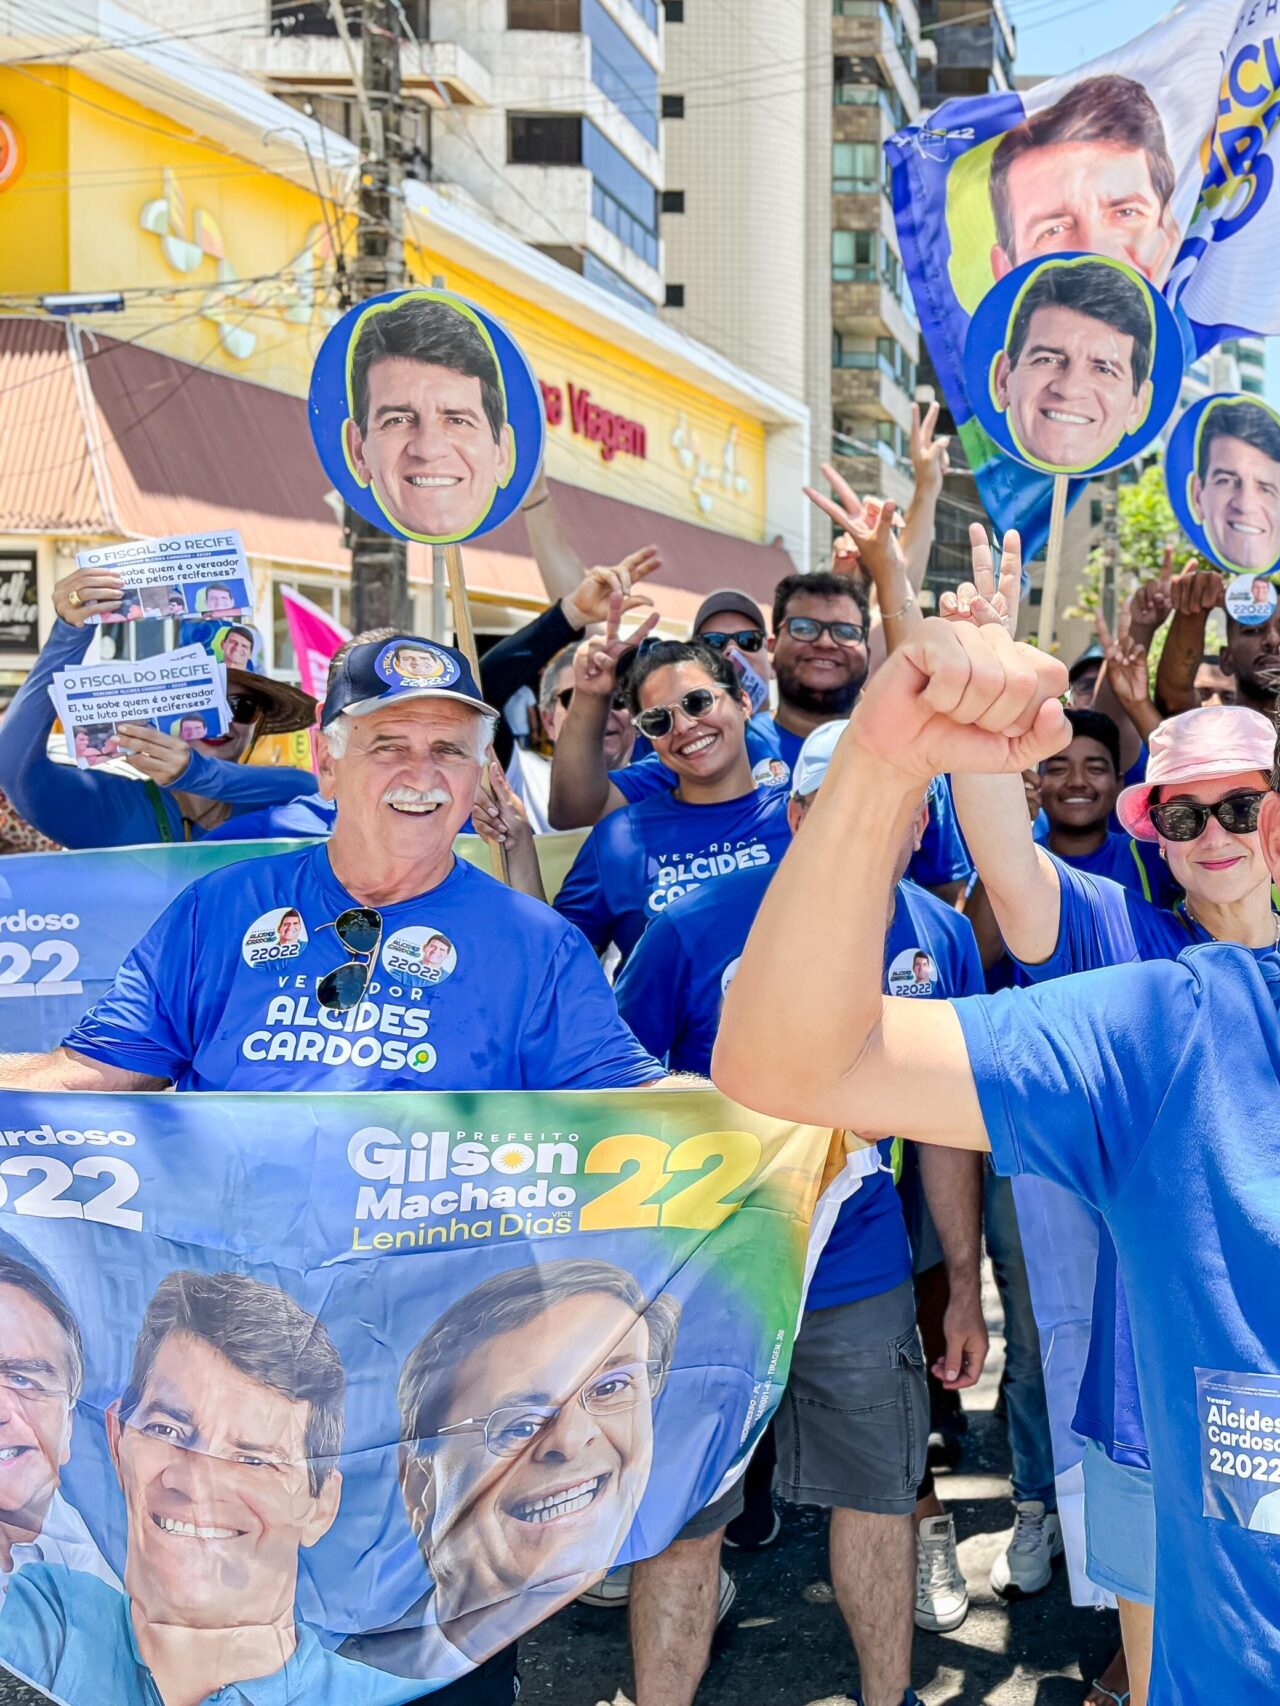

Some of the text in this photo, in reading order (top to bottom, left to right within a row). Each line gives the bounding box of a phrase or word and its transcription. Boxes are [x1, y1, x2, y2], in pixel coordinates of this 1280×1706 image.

[566, 381, 647, 462] Viagem
[88, 536, 235, 564] O FISCAL DO RECIFE
[146, 574, 175, 585] pelos
[177, 567, 237, 581] recifenses?
[148, 565, 175, 576] quem
[186, 563, 193, 571] o
[194, 558, 239, 569] vereador
[64, 663, 211, 689] O FISCAL DO RECIFE
[75, 698, 212, 722] que luta pelos recifenses?
[82, 702, 94, 711] tu
[96, 698, 120, 710] sabe
[122, 697, 150, 710] quem
[161, 695, 168, 703] o
[169, 689, 215, 701] vereador
[658, 844, 771, 887] ALCIDES
[250, 944, 299, 961] 22022
[388, 955, 440, 981] 22022
[896, 983, 931, 996] 22022
[266, 995, 430, 1039] ALCIDES
[242, 1031, 438, 1073] CARDOSO
[456, 1131, 580, 1143] PREFEITO
[347, 1126, 579, 1185] Gilson
[0, 1155, 144, 1232] 22
[579, 1131, 763, 1232] 22
[354, 1179, 577, 1221] Machado
[551, 1210, 573, 1218] VICE
[352, 1214, 573, 1251] Leninha Dias
